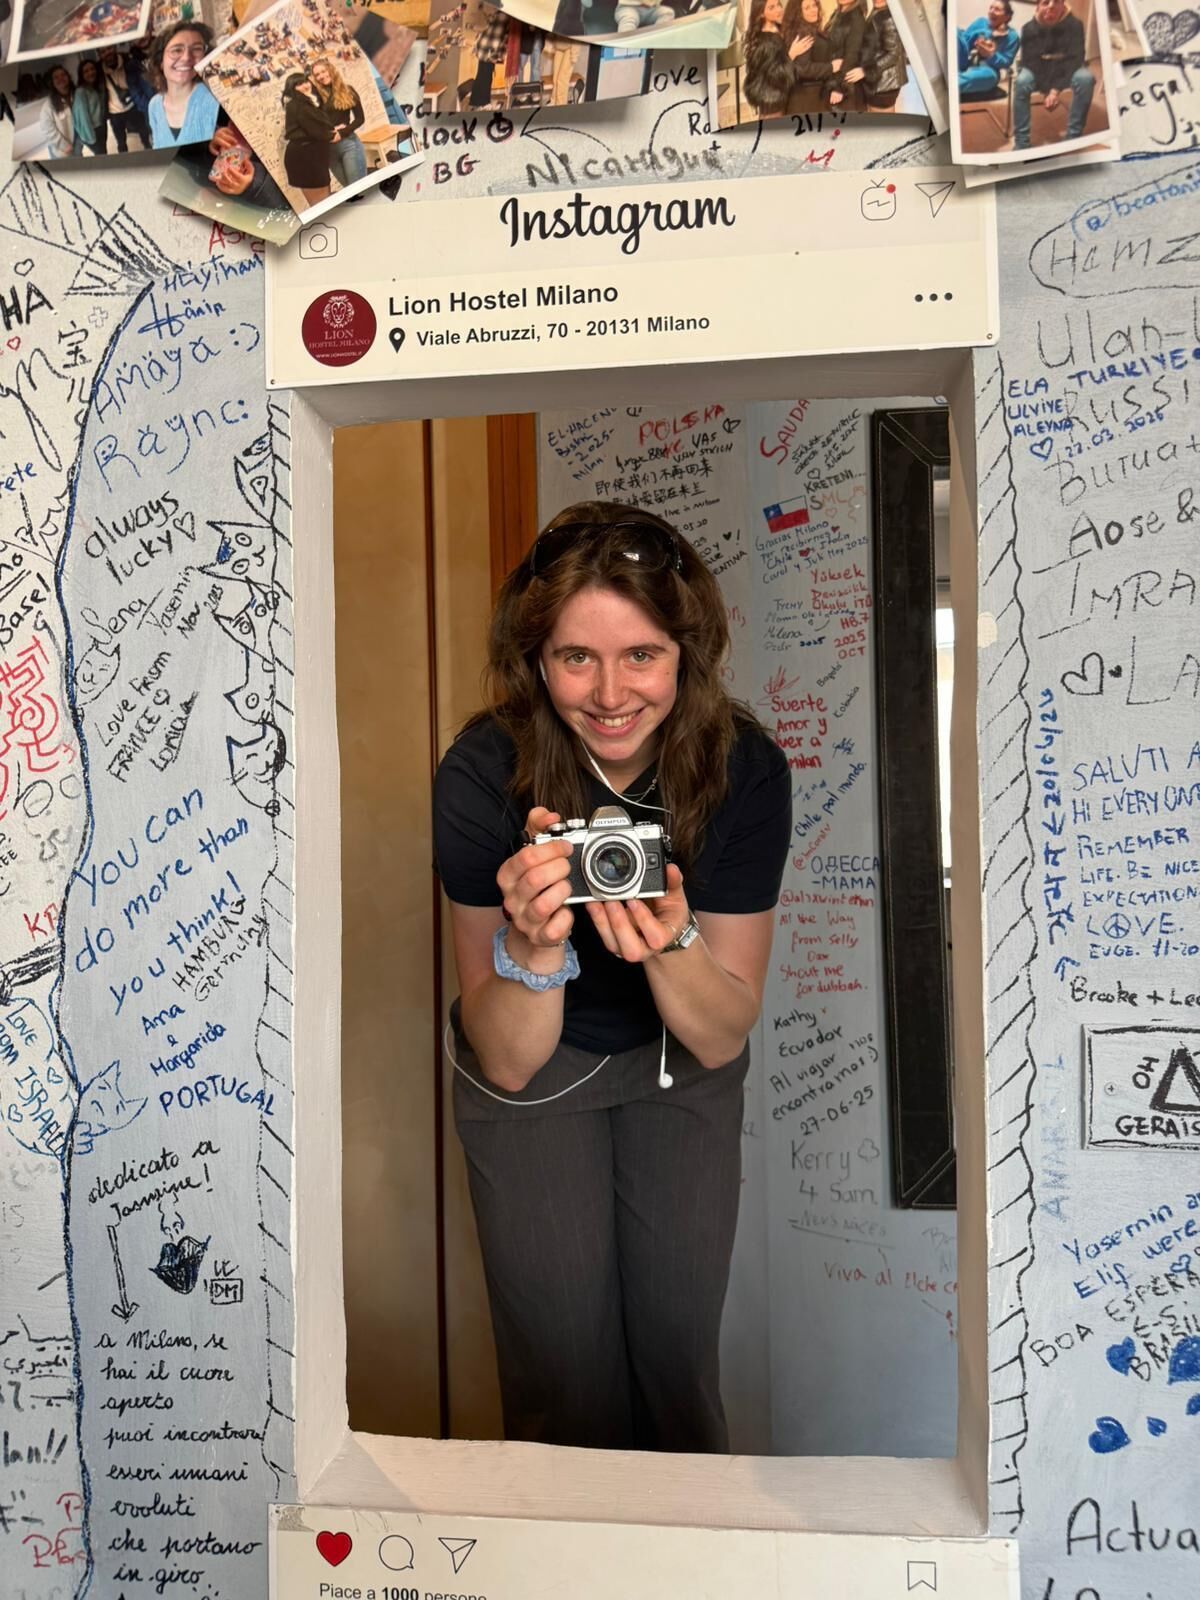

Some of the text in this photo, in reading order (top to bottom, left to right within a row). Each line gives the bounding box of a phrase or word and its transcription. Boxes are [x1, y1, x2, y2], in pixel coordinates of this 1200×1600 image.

[499, 193, 735, 255] Instagram
[389, 284, 619, 317] Lion Hostel Milano
[324, 329, 354, 340] LION
[416, 327, 461, 347] Viale
[465, 323, 541, 345] Abruzzi,
[547, 322, 568, 339] 70
[586, 318, 641, 337] 20131
[647, 315, 710, 333] Milano
[1008, 377, 1049, 398] ELA
[639, 404, 726, 446] POLSKA
[85, 490, 180, 559] always
[106, 529, 172, 586] lucky
[811, 562, 865, 585] Yüksek
[833, 629, 867, 648] 2025
[838, 646, 866, 660] OCT
[771, 694, 829, 713] Suerte
[776, 718, 811, 735] Amor
[1072, 743, 1170, 791] SALUTI
[595, 818, 627, 826] OLYMPUS
[1076, 826, 1190, 861] REMEMBER
[75, 816, 249, 973] do more than
[109, 957, 166, 1016] you
[6, 1001, 39, 1047] LOVE
[773, 1008, 818, 1032] Kathy
[778, 1025, 844, 1058] Ecuador
[158, 1074, 275, 1117] PORTUGAL
[799, 1085, 875, 1137] 27-06-25
[88, 1146, 180, 1204] dedicato
[791, 1138, 850, 1181] Kerry
[823, 1261, 868, 1283] Viva
[126, 1328, 199, 1352] Milano,
[1029, 1322, 1095, 1368] BOA
[100, 1356, 138, 1381] hai
[180, 1365, 235, 1382] cuore
[99, 1391, 174, 1418] aperto
[103, 1421, 154, 1450] puoi
[168, 1461, 249, 1482] umani
[110, 1491, 197, 1519] evoluti
[108, 1528, 264, 1560] che portano
[113, 1563, 144, 1582] in
